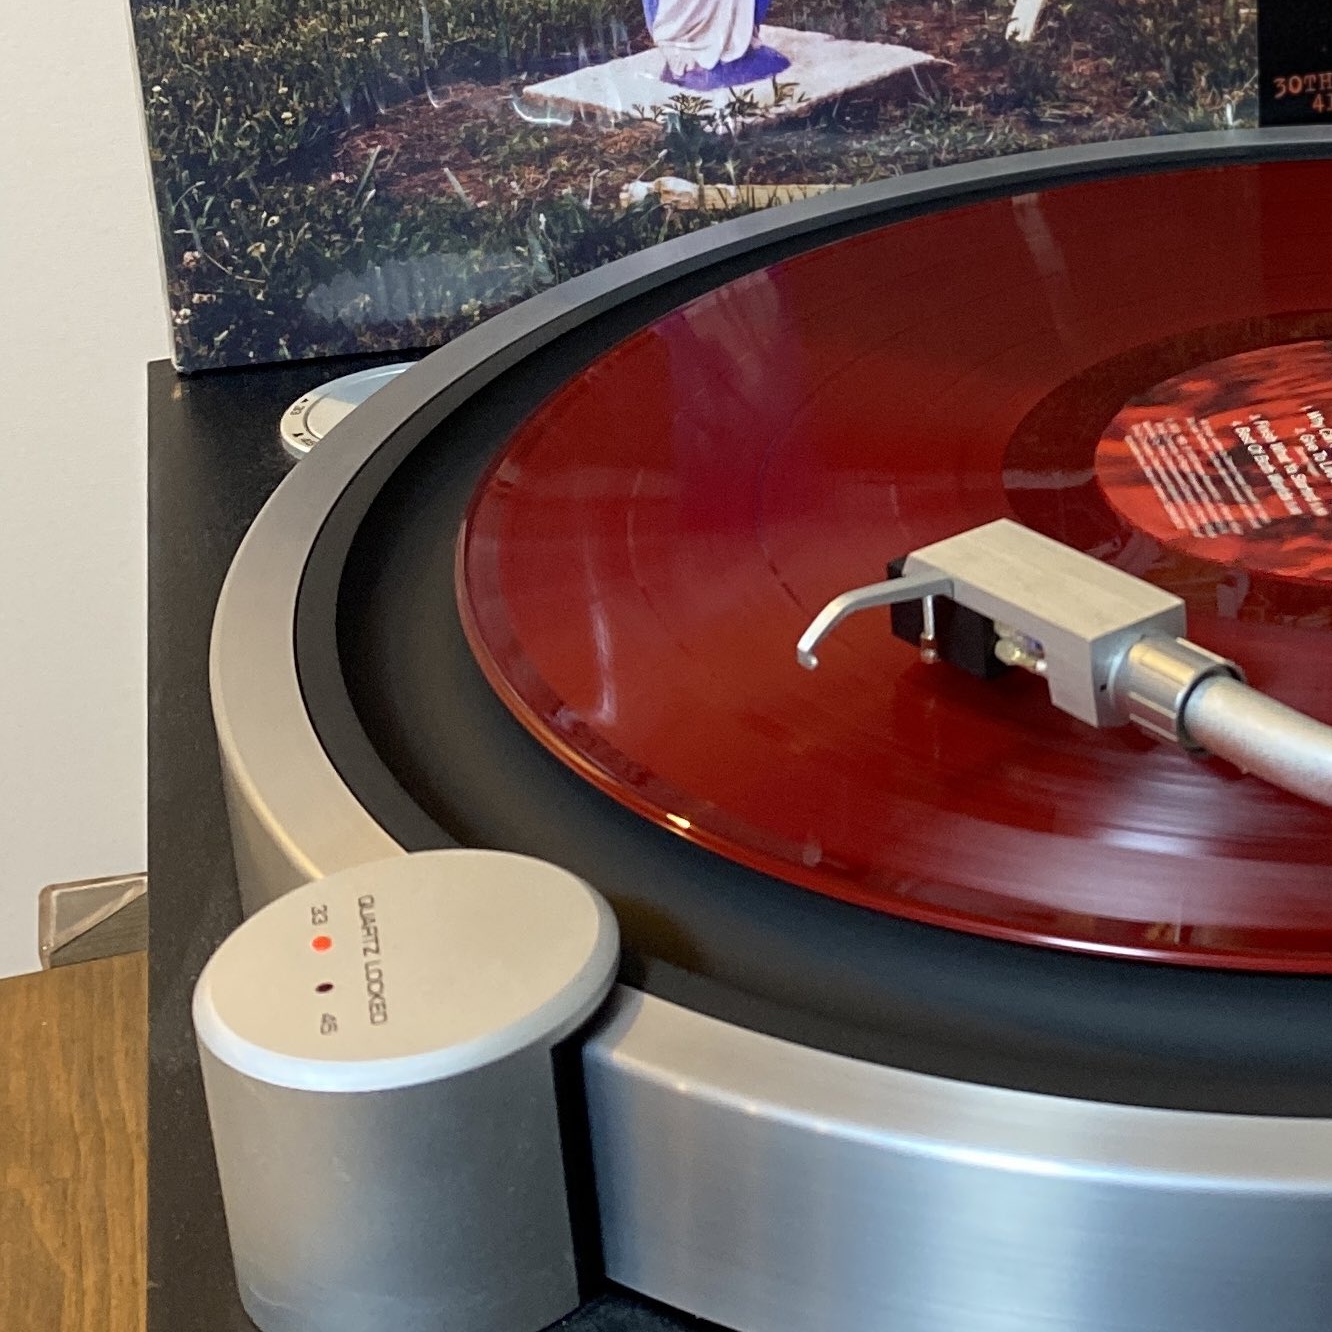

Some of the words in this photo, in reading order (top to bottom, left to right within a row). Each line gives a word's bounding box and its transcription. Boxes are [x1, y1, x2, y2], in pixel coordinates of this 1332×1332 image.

[311, 904, 328, 926] 33
[358, 894, 381, 957] QUARTZ
[364, 960, 388, 1026] LOCKED
[319, 1012, 338, 1036] 45
